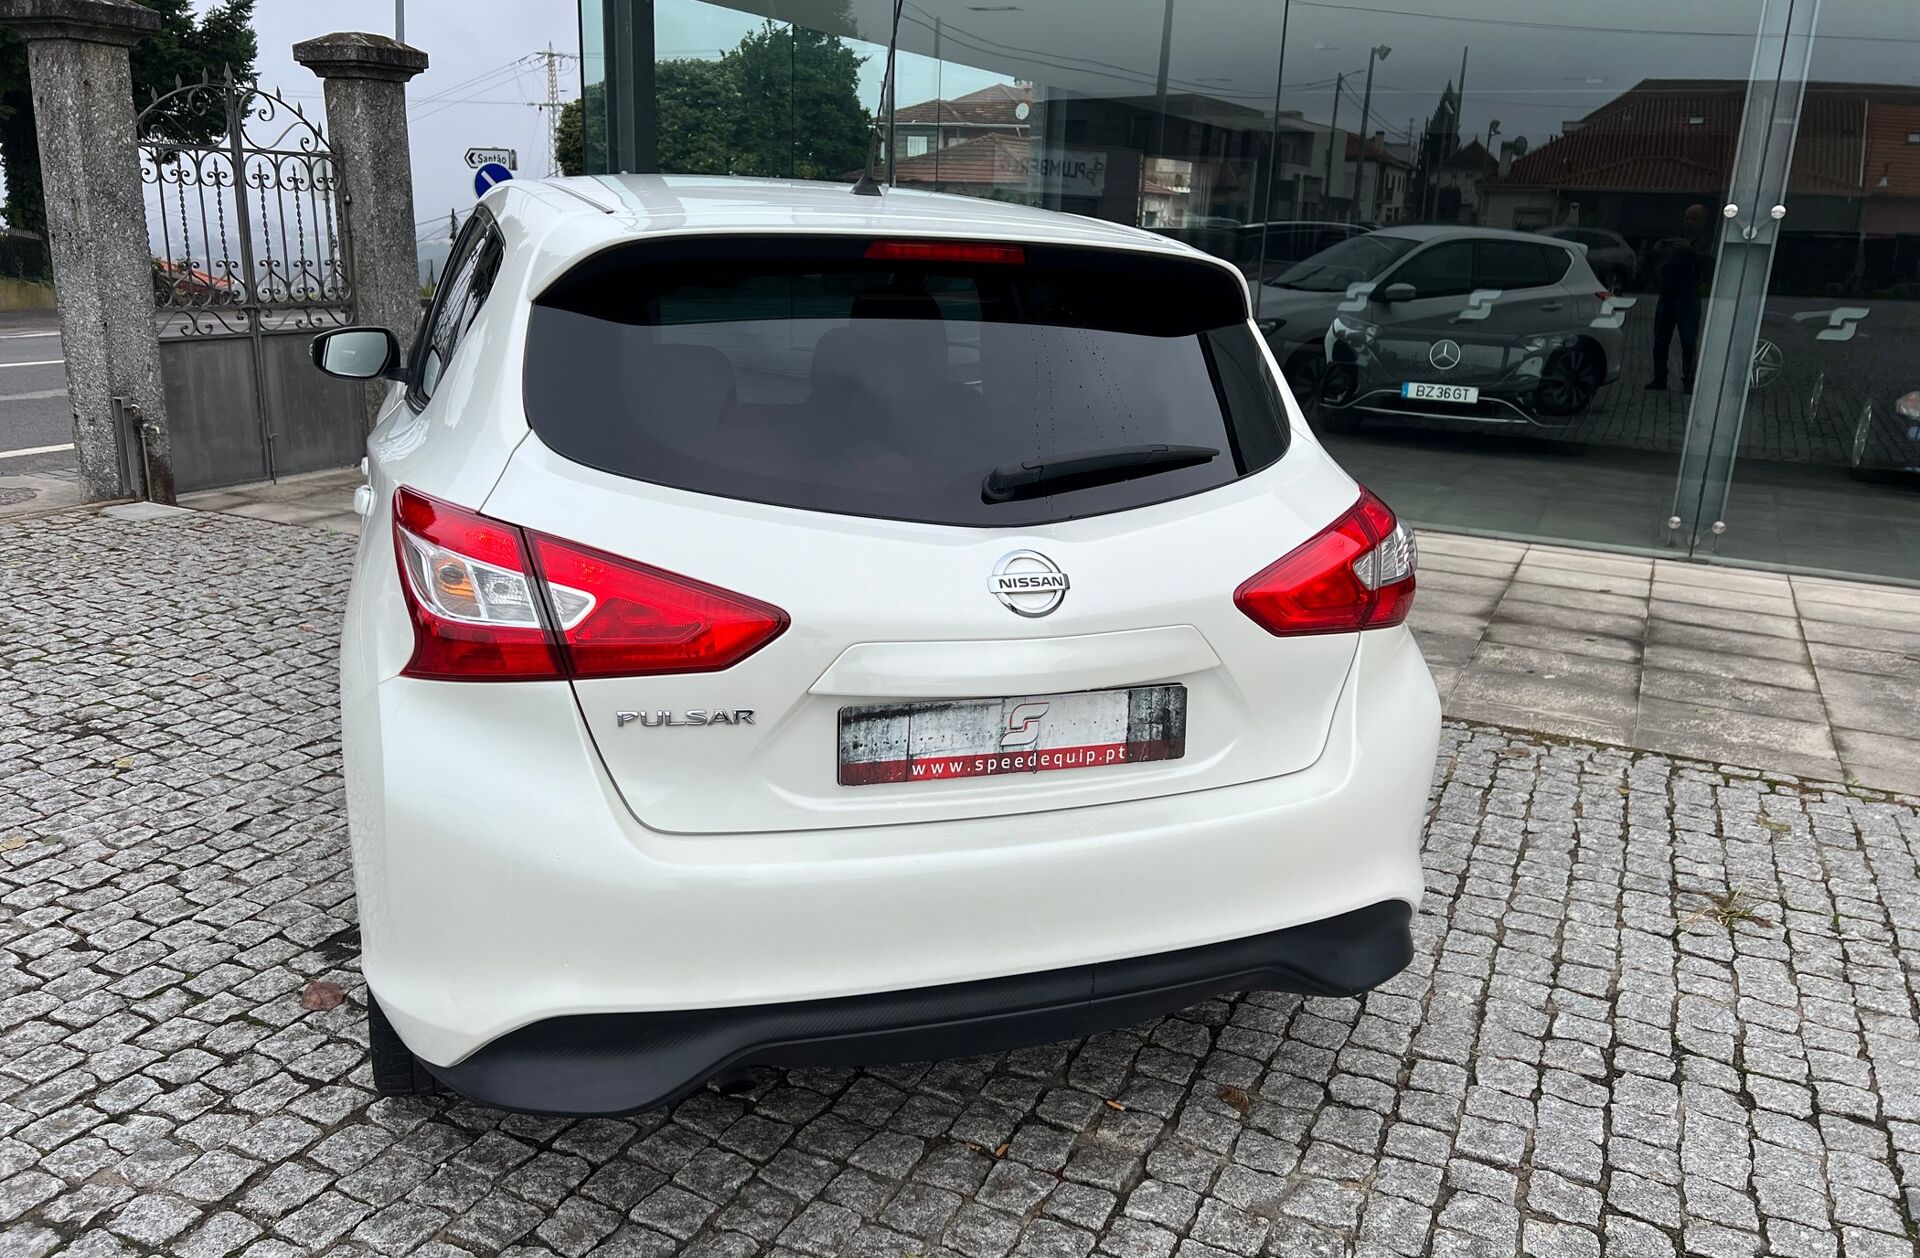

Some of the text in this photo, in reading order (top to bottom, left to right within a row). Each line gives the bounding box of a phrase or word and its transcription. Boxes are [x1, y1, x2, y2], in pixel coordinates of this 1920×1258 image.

[477, 153, 507, 165] Santão
[998, 576, 1064, 589] NISSAN
[615, 708, 756, 727] PULSAR
[911, 746, 1126, 776] www.speedequip.pt
